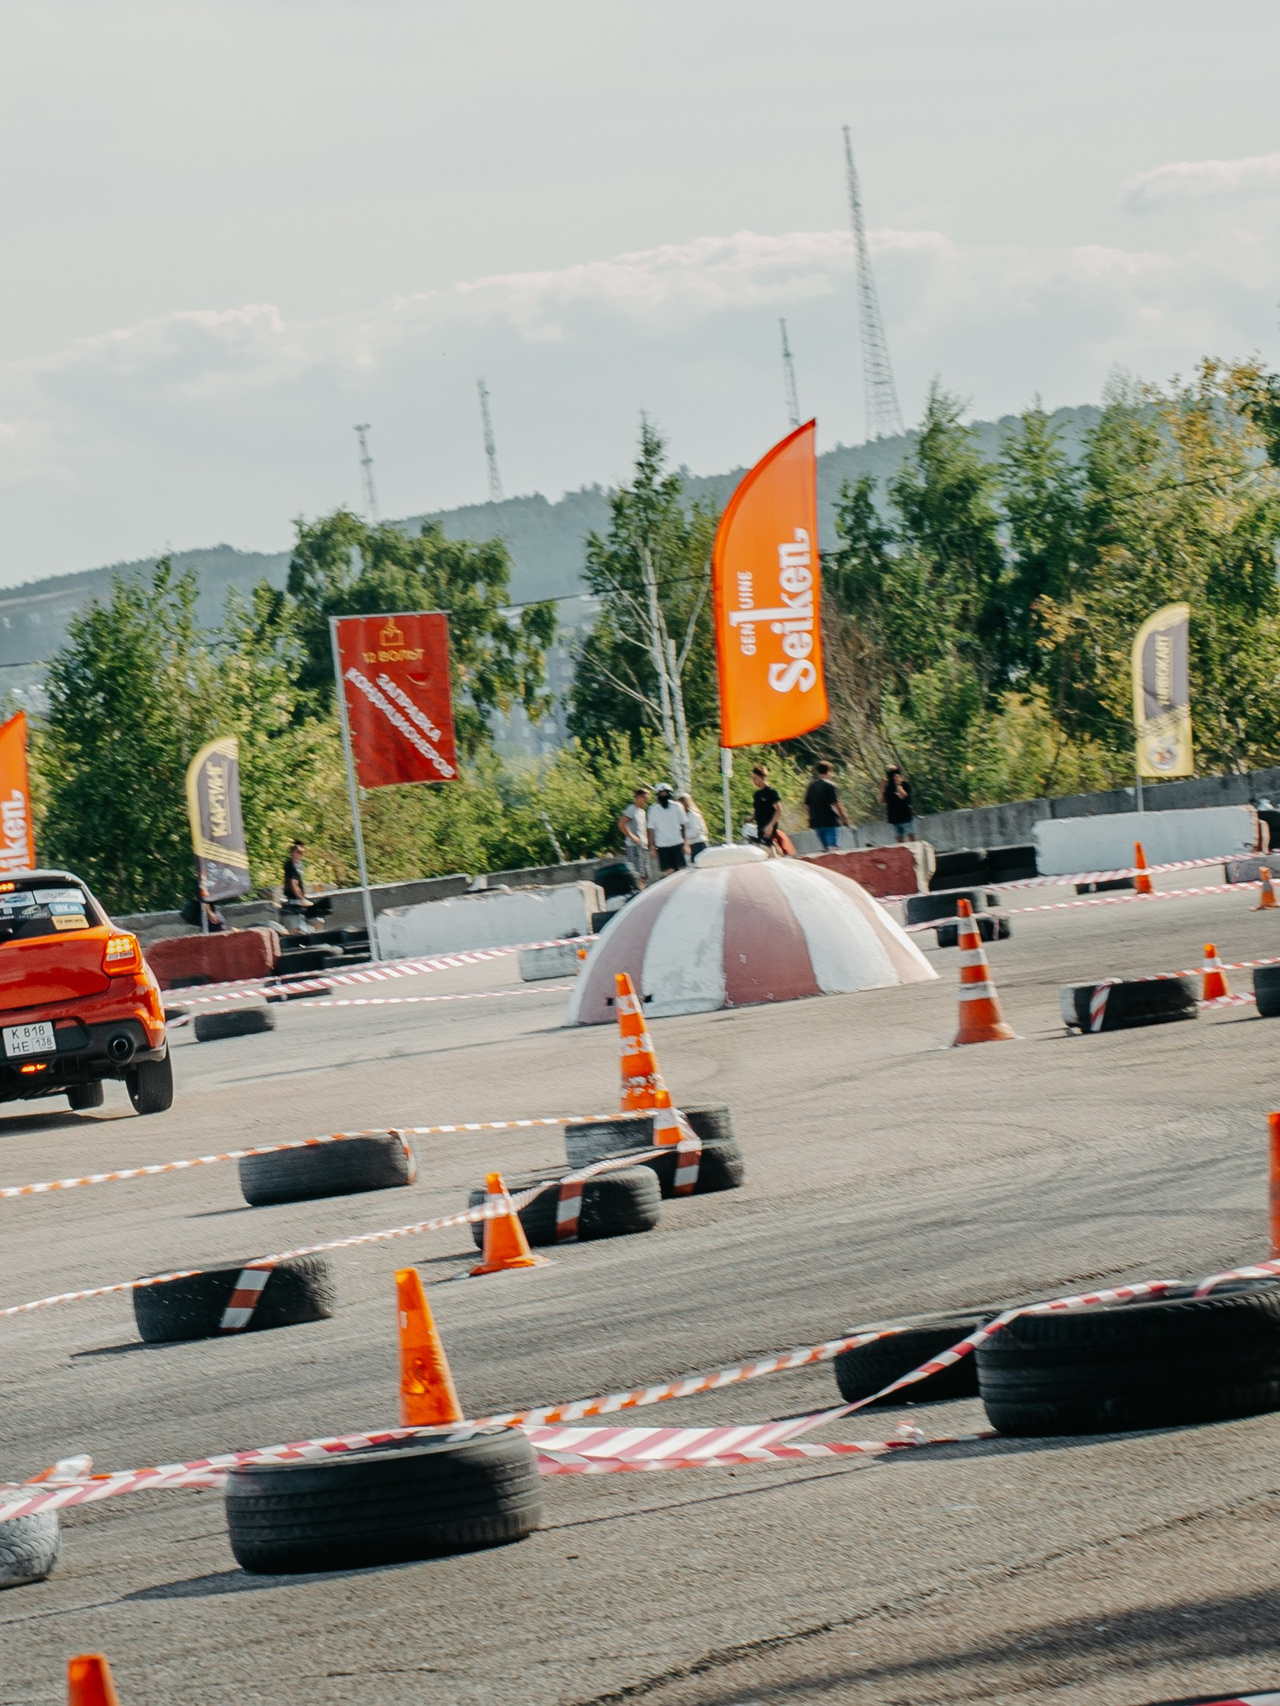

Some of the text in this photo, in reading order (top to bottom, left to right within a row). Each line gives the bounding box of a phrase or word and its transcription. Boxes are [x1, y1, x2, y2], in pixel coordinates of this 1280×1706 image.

[729, 527, 817, 693] Seiken
[345, 667, 455, 778] КОНДИЦИОНЕРОВ
[376, 673, 442, 742] ЗАПРАВКА
[23, 1025, 46, 1038] 818
[35, 1037, 53, 1047] 138
